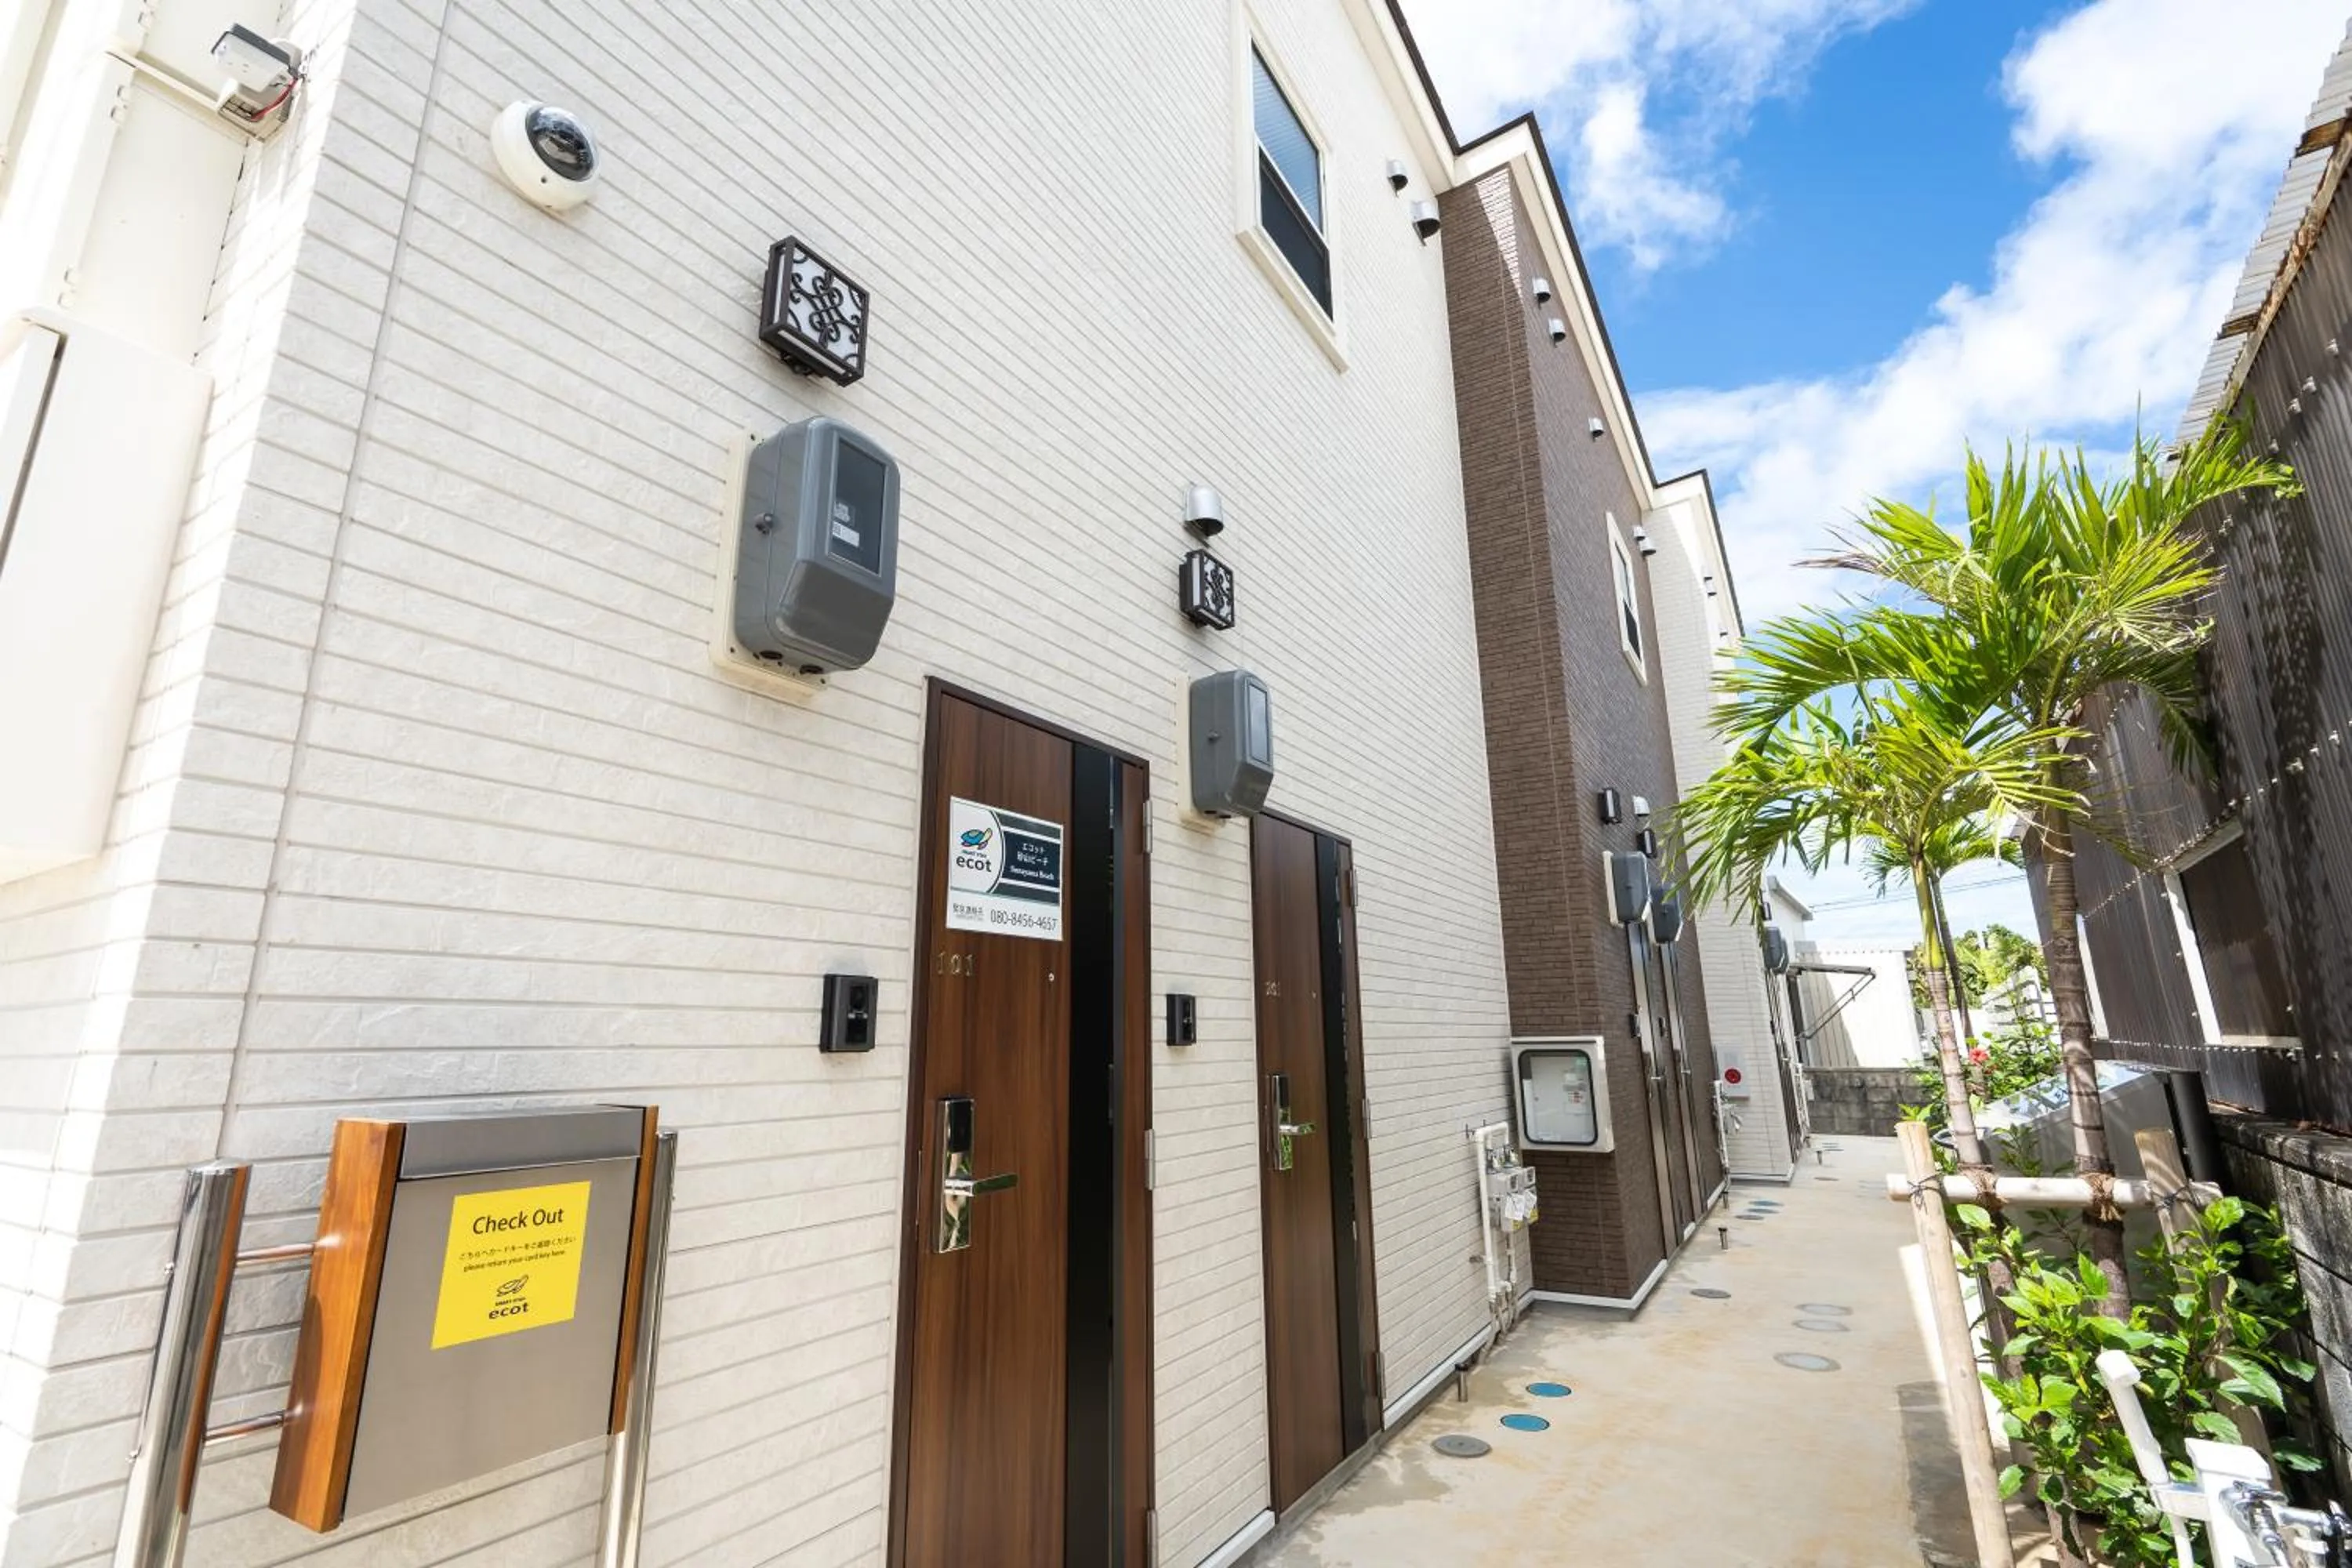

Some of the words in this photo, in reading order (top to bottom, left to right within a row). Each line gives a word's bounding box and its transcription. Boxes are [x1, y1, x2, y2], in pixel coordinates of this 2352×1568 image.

[956, 855, 992, 872] ecot
[473, 1210, 528, 1235] Check
[532, 1207, 564, 1226] Out
[488, 1301, 528, 1319] ecot
